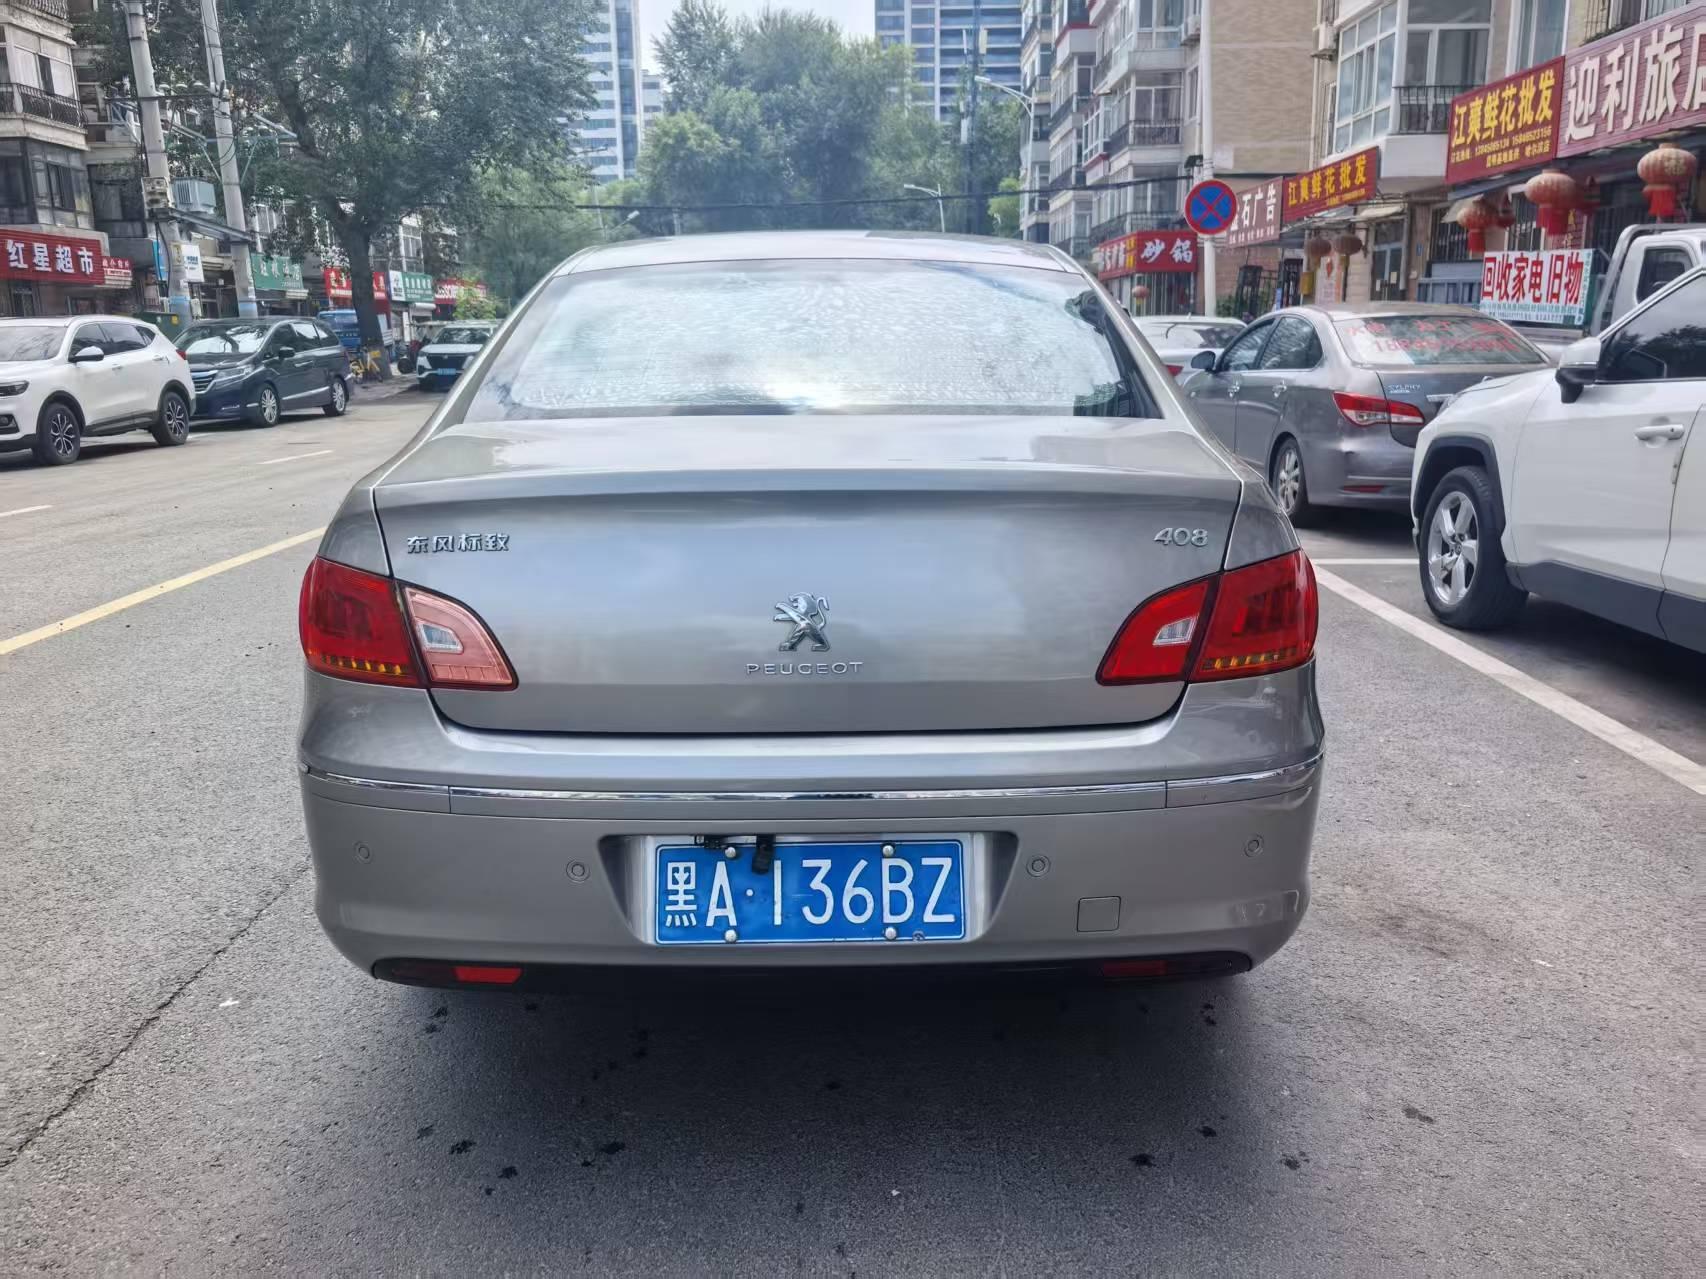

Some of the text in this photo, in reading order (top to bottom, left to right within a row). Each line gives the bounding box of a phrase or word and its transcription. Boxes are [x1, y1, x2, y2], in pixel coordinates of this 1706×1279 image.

[1451, 68, 1555, 148] 江爽鲜花批发
[1288, 154, 1367, 206] 江爽鲜花批发
[6, 239, 94, 275] 红星超市
[1140, 237, 1193, 263] 砂锅
[1482, 251, 1584, 305] 回收家电旧物
[407, 533, 510, 554] 东风标致
[1154, 527, 1208, 547] 408
[746, 661, 864, 675] PEUGEOT
